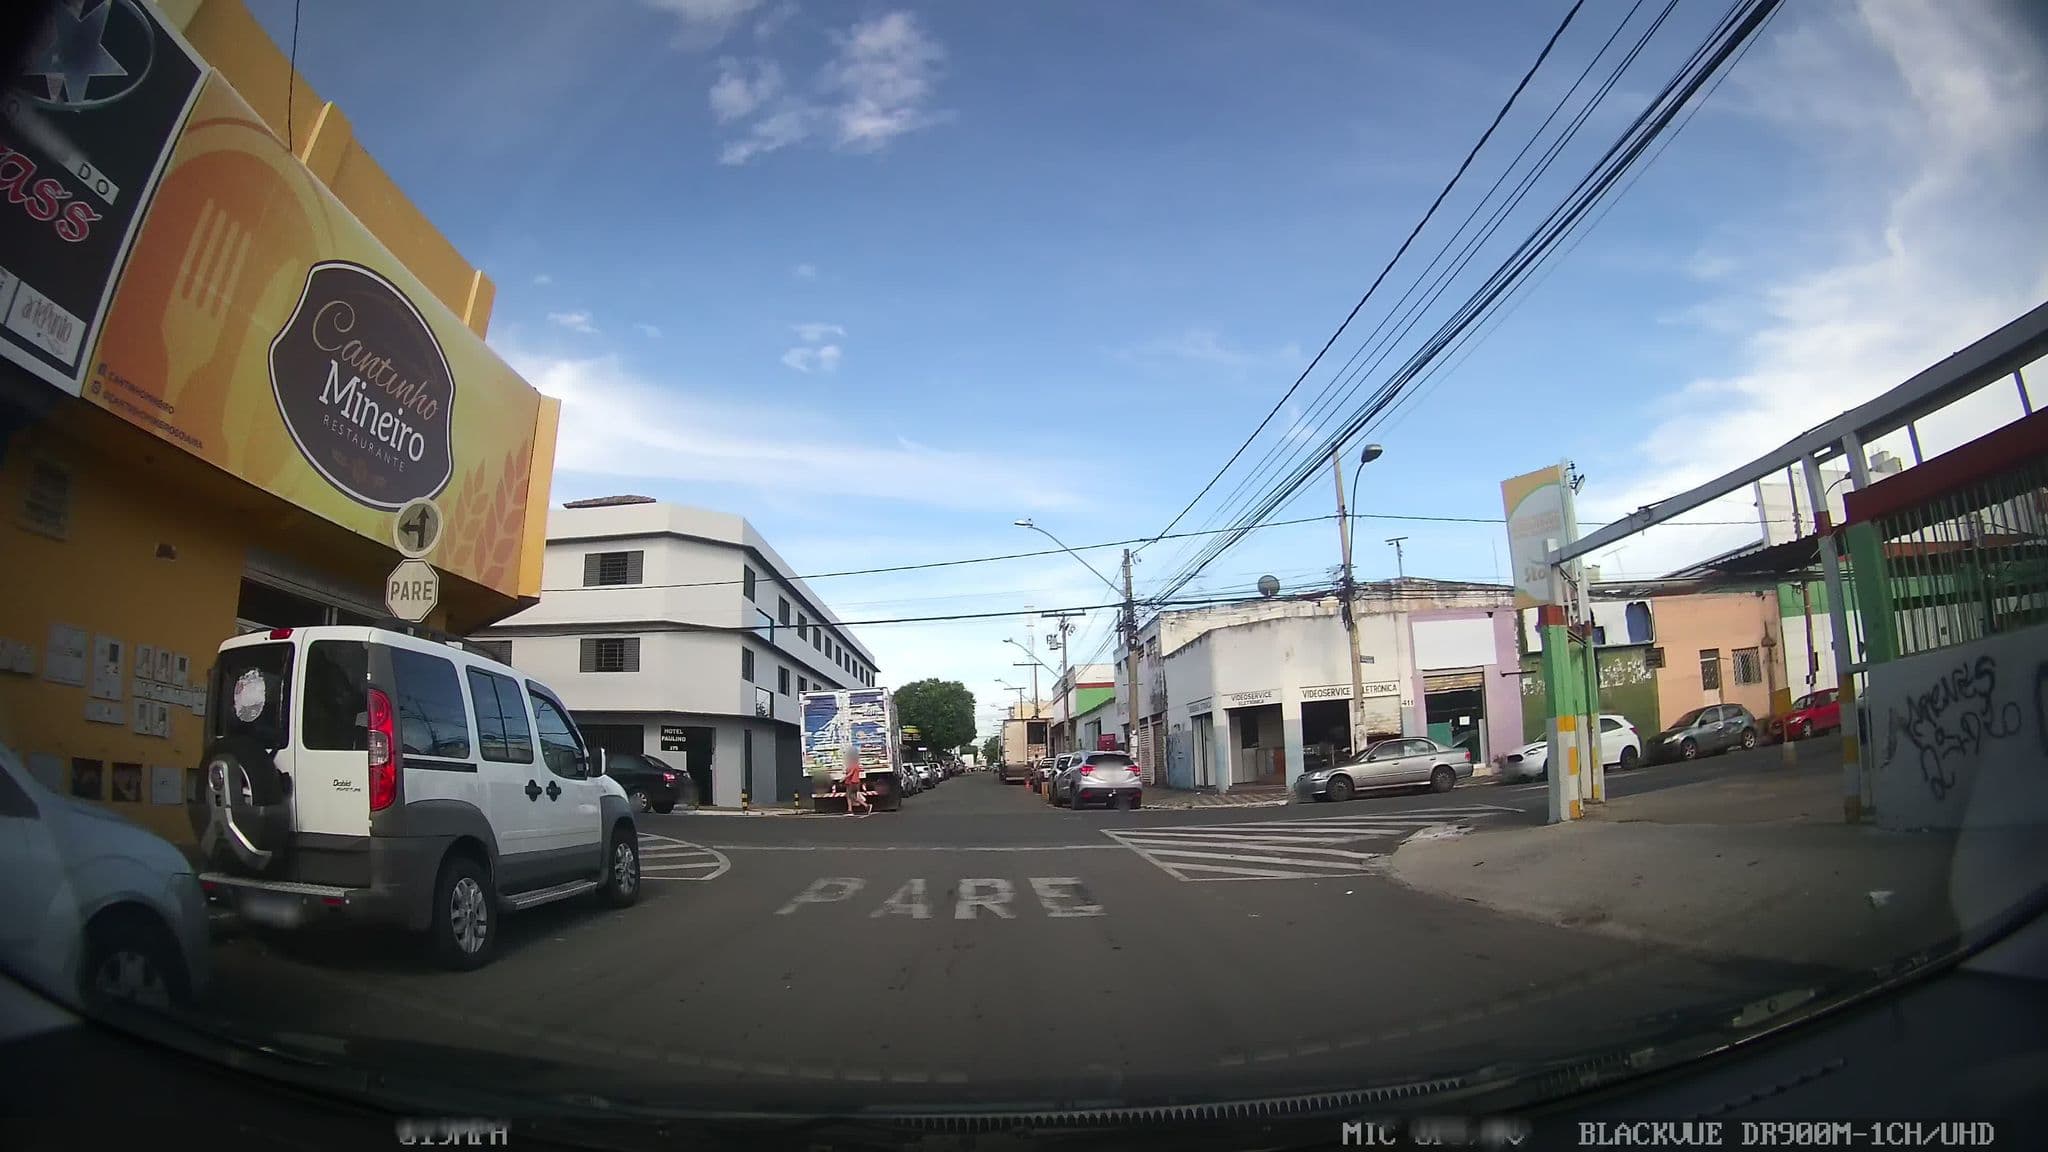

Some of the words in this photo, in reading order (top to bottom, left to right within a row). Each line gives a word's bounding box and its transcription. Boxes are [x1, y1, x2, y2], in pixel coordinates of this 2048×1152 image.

[0, 145, 103, 243] ass
[78, 162, 110, 196] DO
[312, 300, 438, 421] Cantinho
[318, 359, 425, 462] Mineiro
[323, 414, 407, 473] RESTAURANTE
[390, 580, 434, 601] PARE
[1302, 687, 1351, 699] VIDEOSERVICE
[774, 877, 1106, 919] PARE
